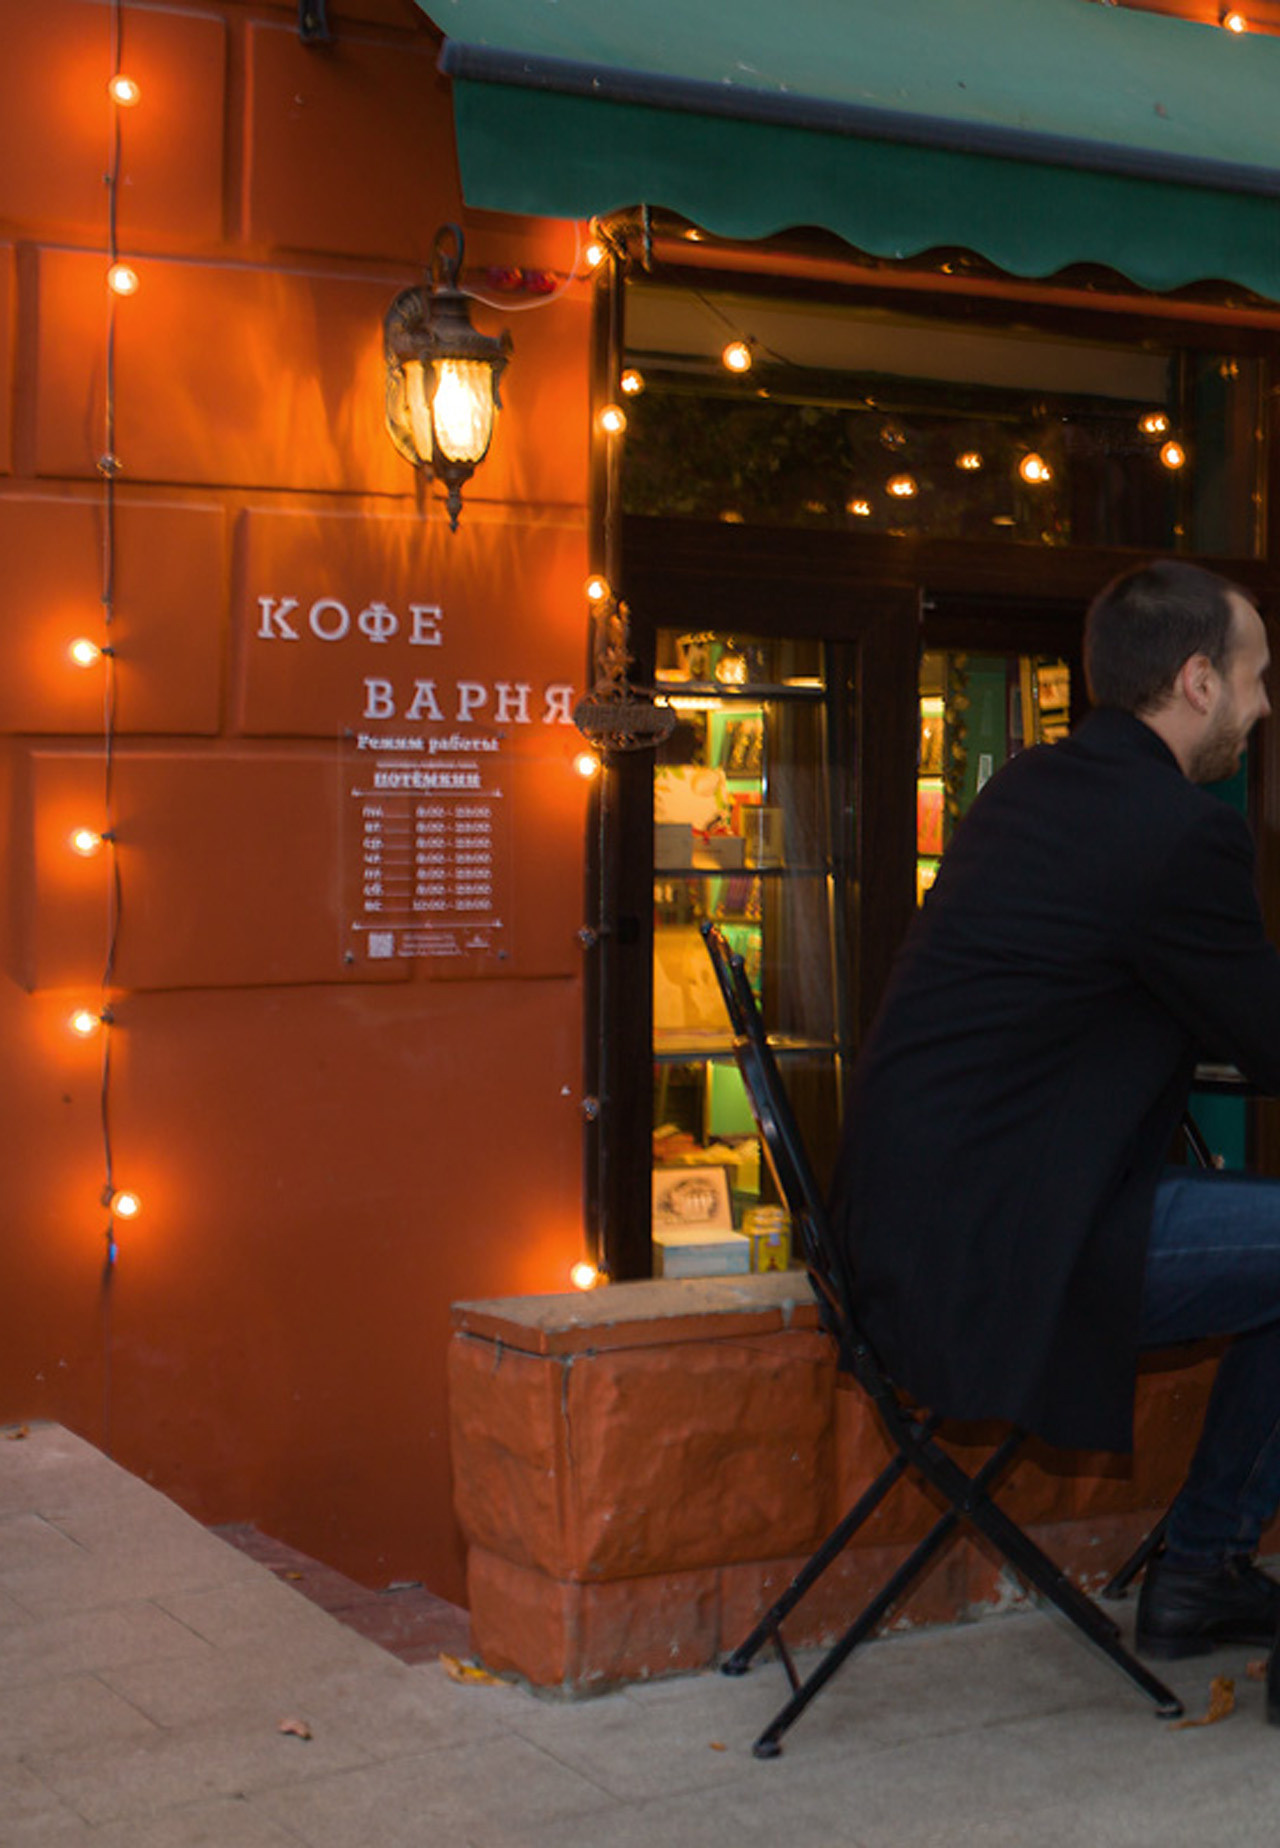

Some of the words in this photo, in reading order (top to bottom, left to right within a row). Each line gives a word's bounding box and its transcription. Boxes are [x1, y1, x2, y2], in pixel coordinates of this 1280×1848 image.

[257, 597, 443, 646] КОФЕ
[363, 677, 575, 725] ВАРНЯ
[357, 734, 424, 751] Режим
[429, 733, 500, 755] работы
